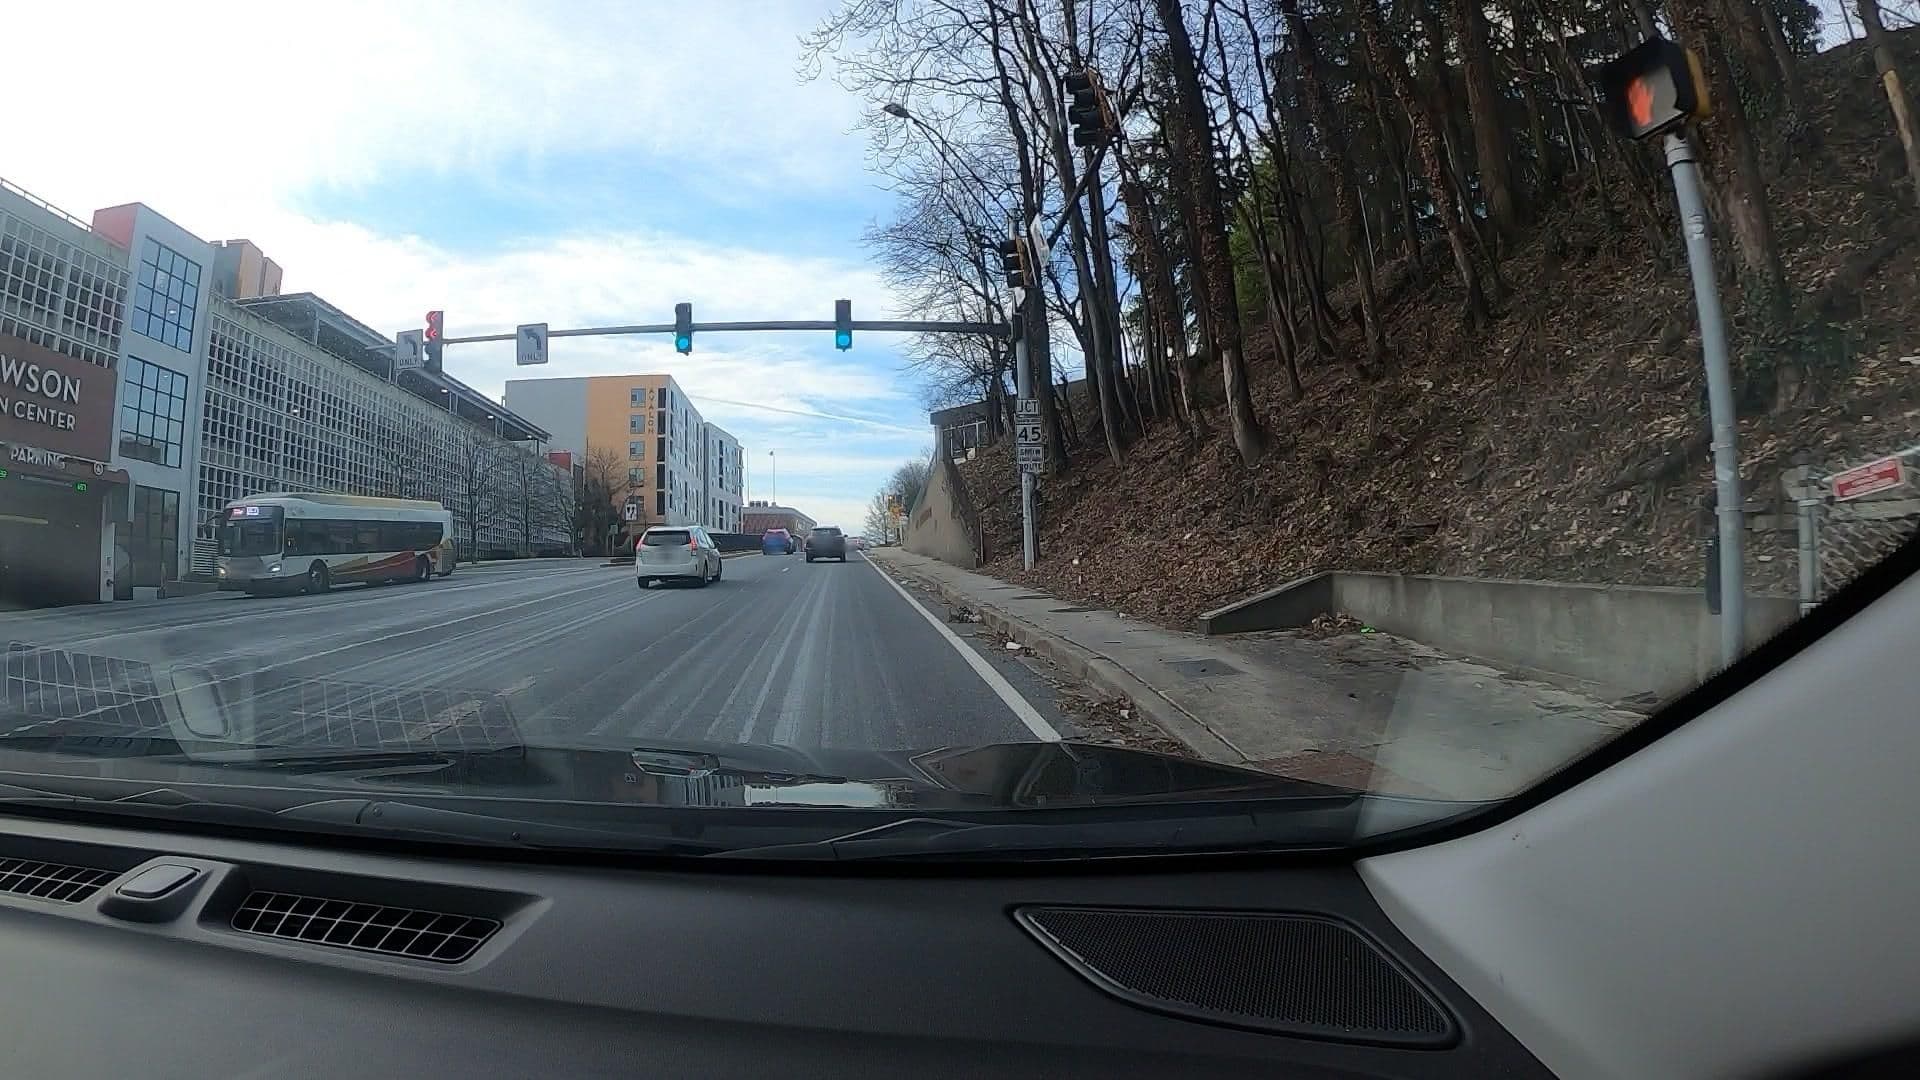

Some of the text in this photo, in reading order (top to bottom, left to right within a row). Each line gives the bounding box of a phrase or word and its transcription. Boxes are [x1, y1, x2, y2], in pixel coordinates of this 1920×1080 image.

[521, 352, 543, 361] ONLY
[0, 355, 81, 405] WSON
[14, 401, 76, 430] CENTER
[1018, 400, 1038, 412] JCT
[1018, 426, 1041, 442] 45
[10, 447, 66, 469] PARKING
